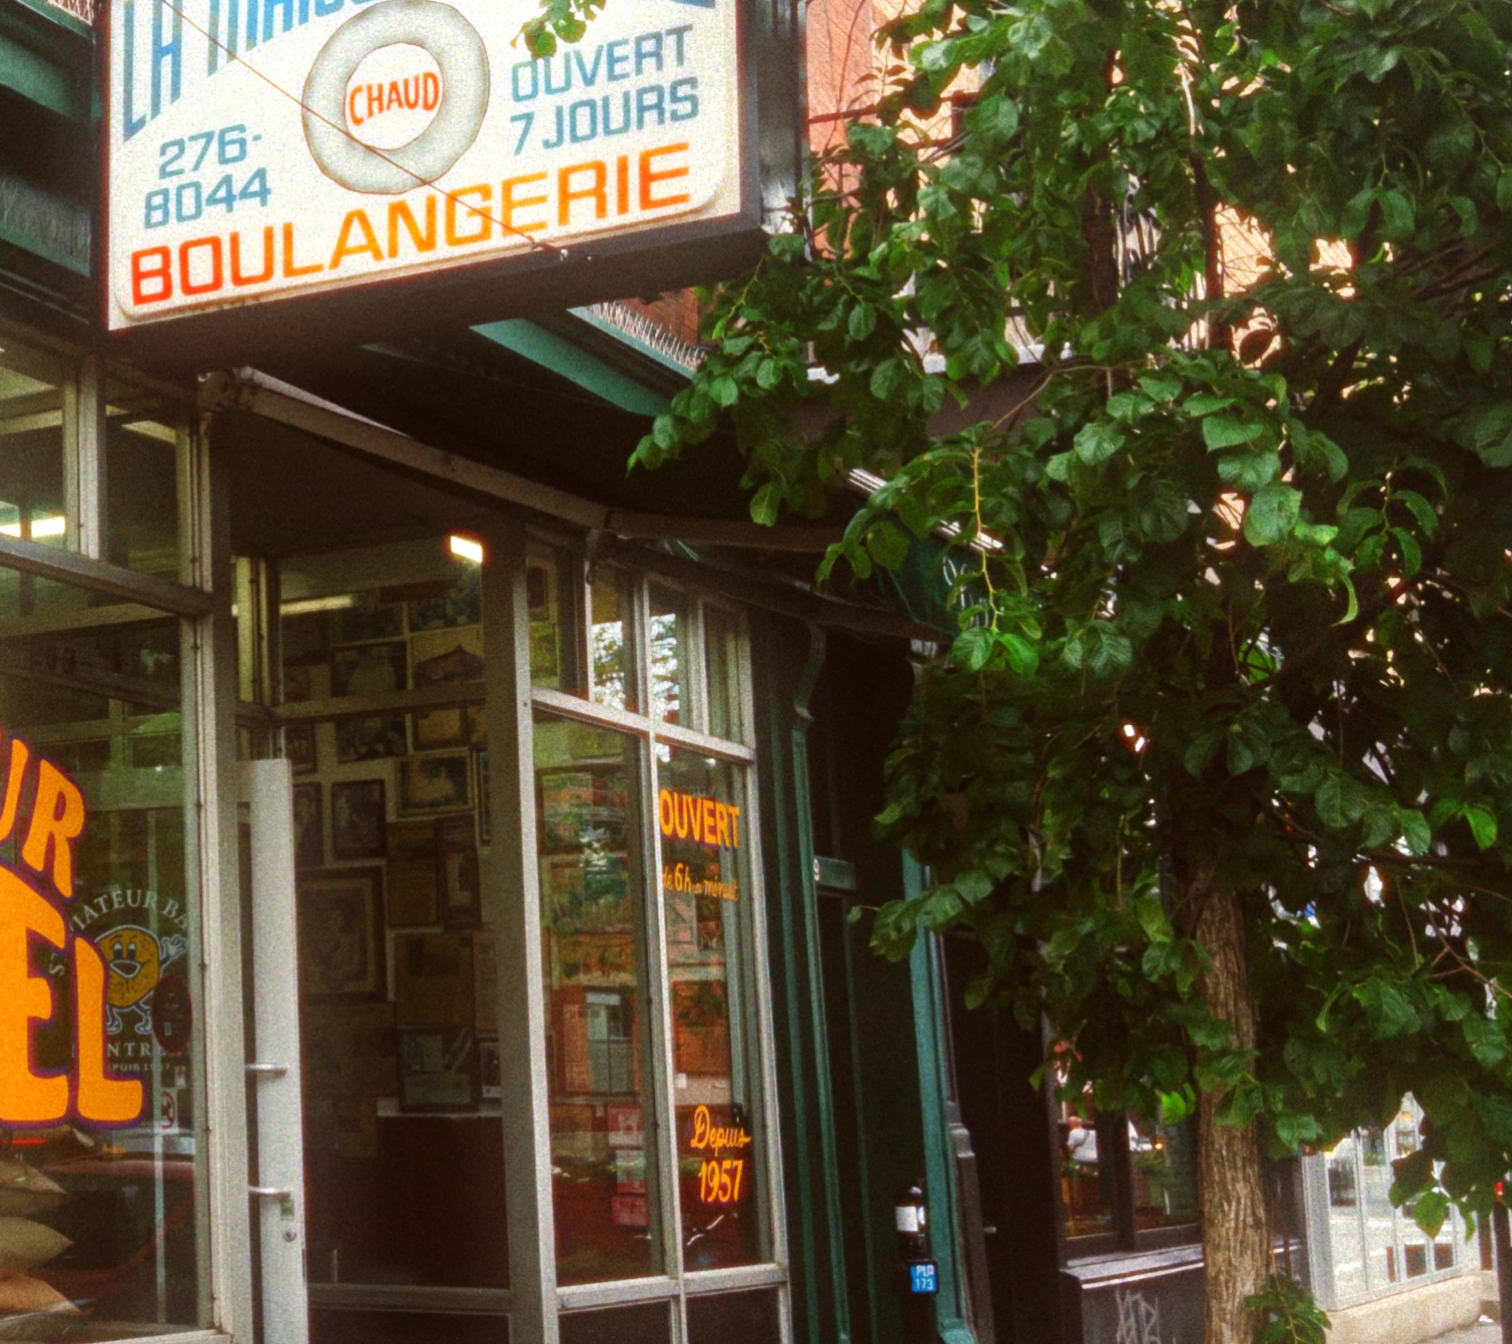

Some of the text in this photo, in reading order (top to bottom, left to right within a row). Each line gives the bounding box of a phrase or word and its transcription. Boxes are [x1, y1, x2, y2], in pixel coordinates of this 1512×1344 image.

[511, 25, 693, 103] OUVERT
[349, 71, 440, 127] CHAUD
[511, 76, 700, 156] 7 JOURS
[130, 142, 691, 307] BOULANGERIE
[144, 167, 271, 229] 8044
[658, 788, 740, 849] OUVERT
[69, 888, 159, 933] IATEUR
[690, 1105, 752, 1157] Depuis
[698, 1159, 744, 1203] 1957
